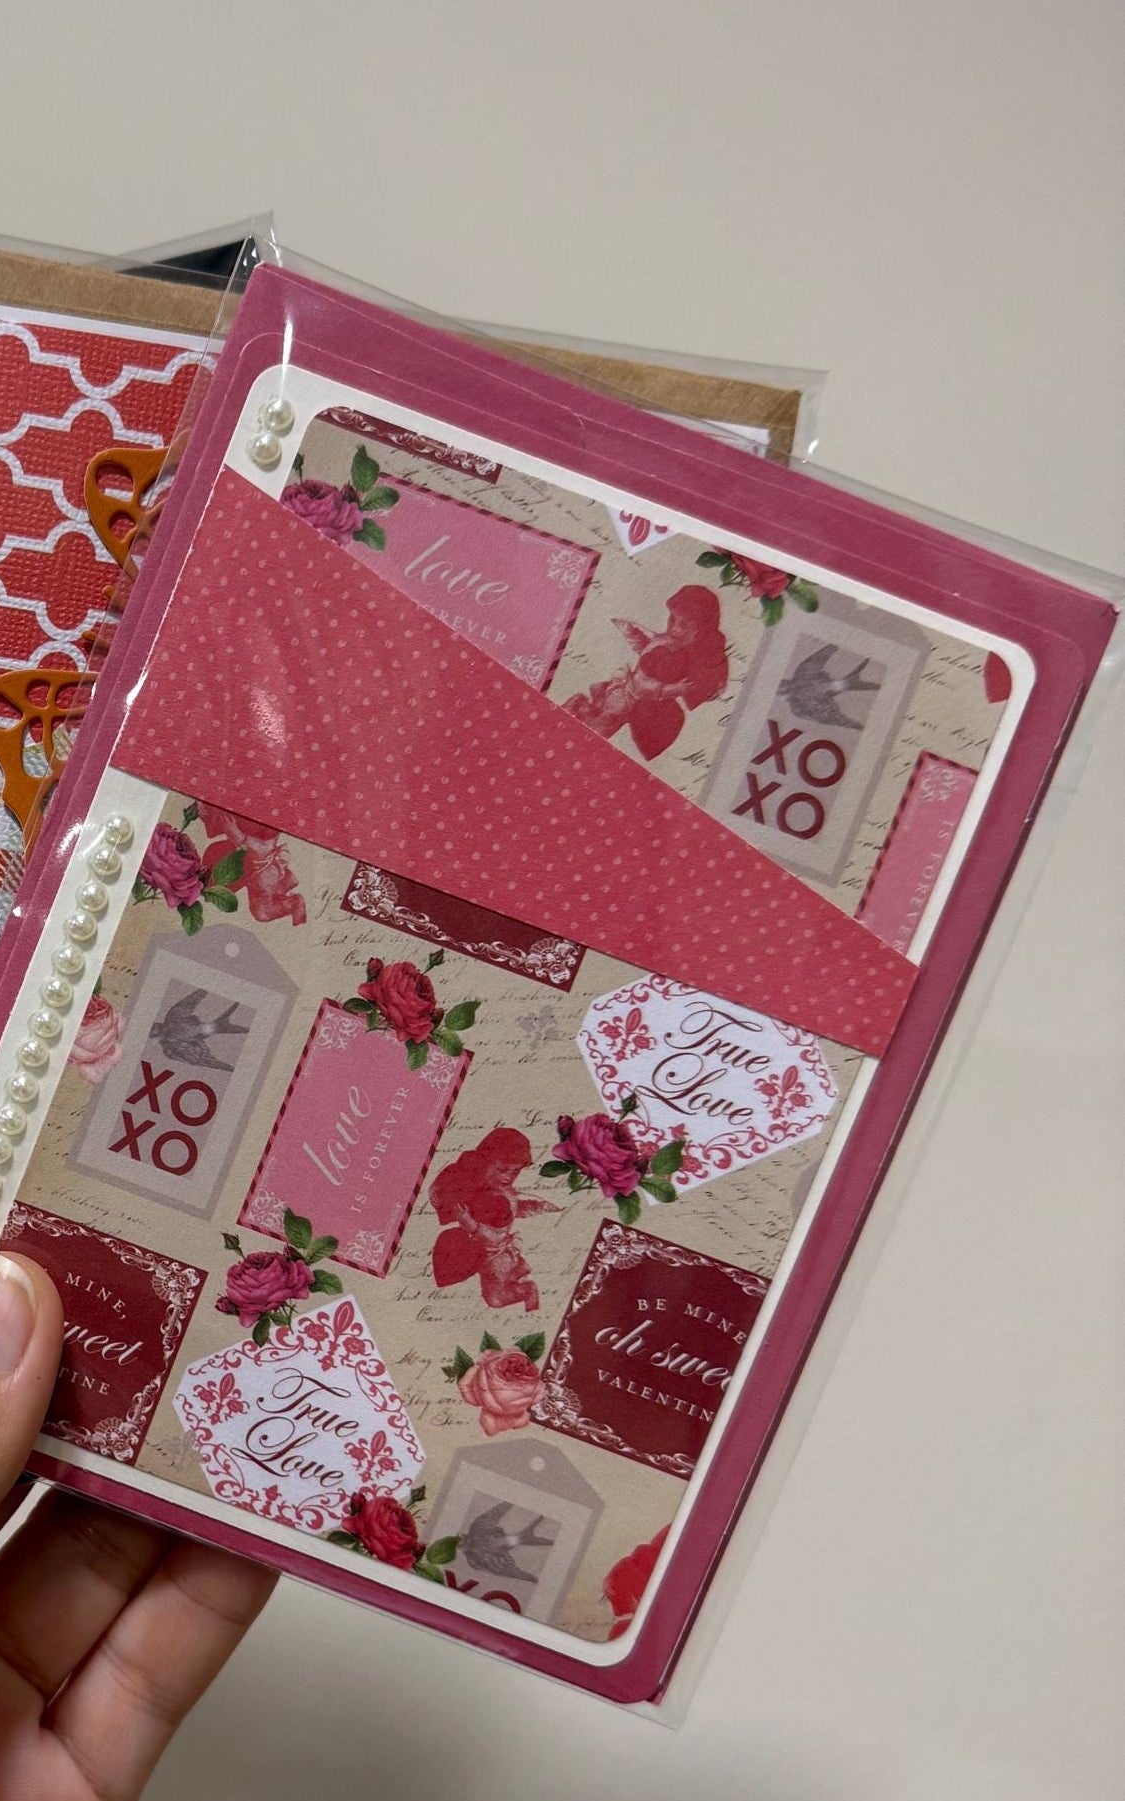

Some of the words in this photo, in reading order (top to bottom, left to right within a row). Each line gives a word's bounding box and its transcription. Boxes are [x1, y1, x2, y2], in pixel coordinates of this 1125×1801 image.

[403, 535, 510, 606] love
[751, 719, 846, 788] XO
[731, 772, 825, 839] XO
[664, 1001, 771, 1073] True
[125, 1060, 217, 1127] XO
[634, 1052, 754, 1126] Love
[108, 1111, 198, 1176] XO
[301, 1086, 372, 1187] love
[350, 1193, 367, 1214] IS
[363, 1086, 411, 1183] FOREVER
[65, 1272, 127, 1320] MINE,
[638, 1298, 667, 1311] BE
[63, 1320, 144, 1367] weet
[594, 1319, 652, 1357] oh
[256, 1368, 359, 1438] True
[229, 1417, 345, 1488] Love
